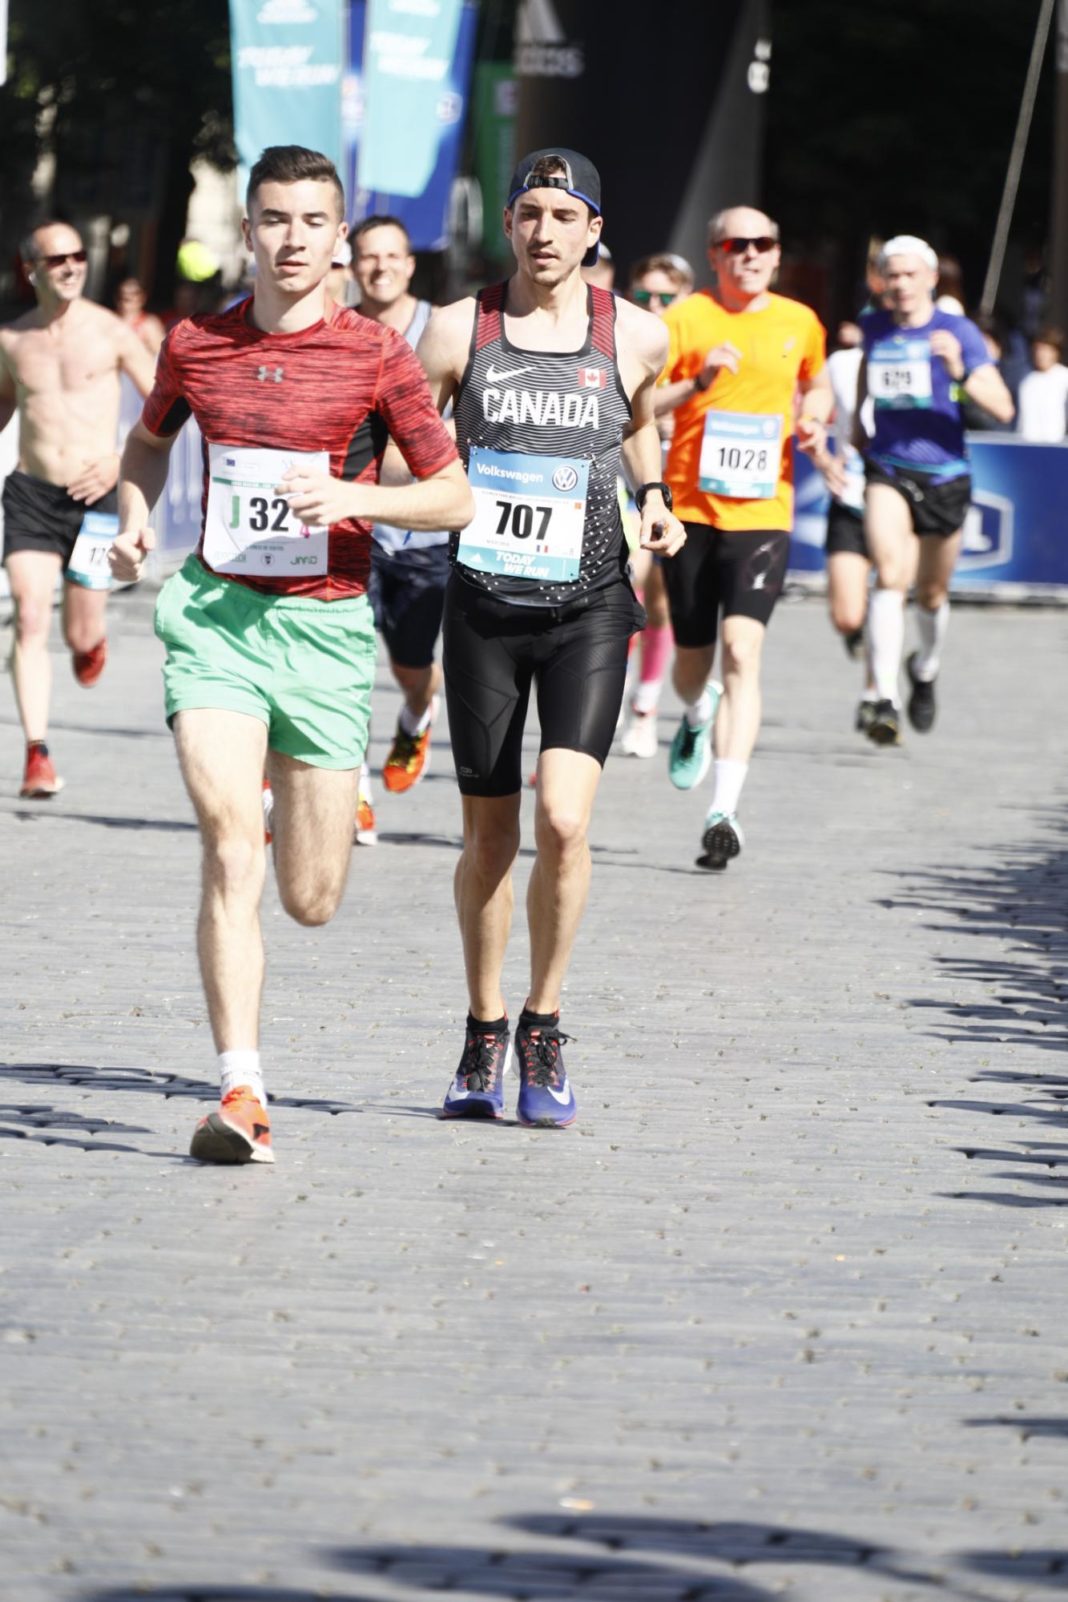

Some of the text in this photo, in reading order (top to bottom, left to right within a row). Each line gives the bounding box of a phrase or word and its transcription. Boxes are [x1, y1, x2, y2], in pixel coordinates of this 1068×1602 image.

[483, 389, 599, 430] CANADA
[718, 447, 767, 471] 1028
[476, 463, 543, 484] Volkswagen
[249, 497, 289, 532] 32
[495, 500, 553, 540] 707
[496, 551, 536, 567] TODAY
[503, 562, 550, 578] WE RUN
